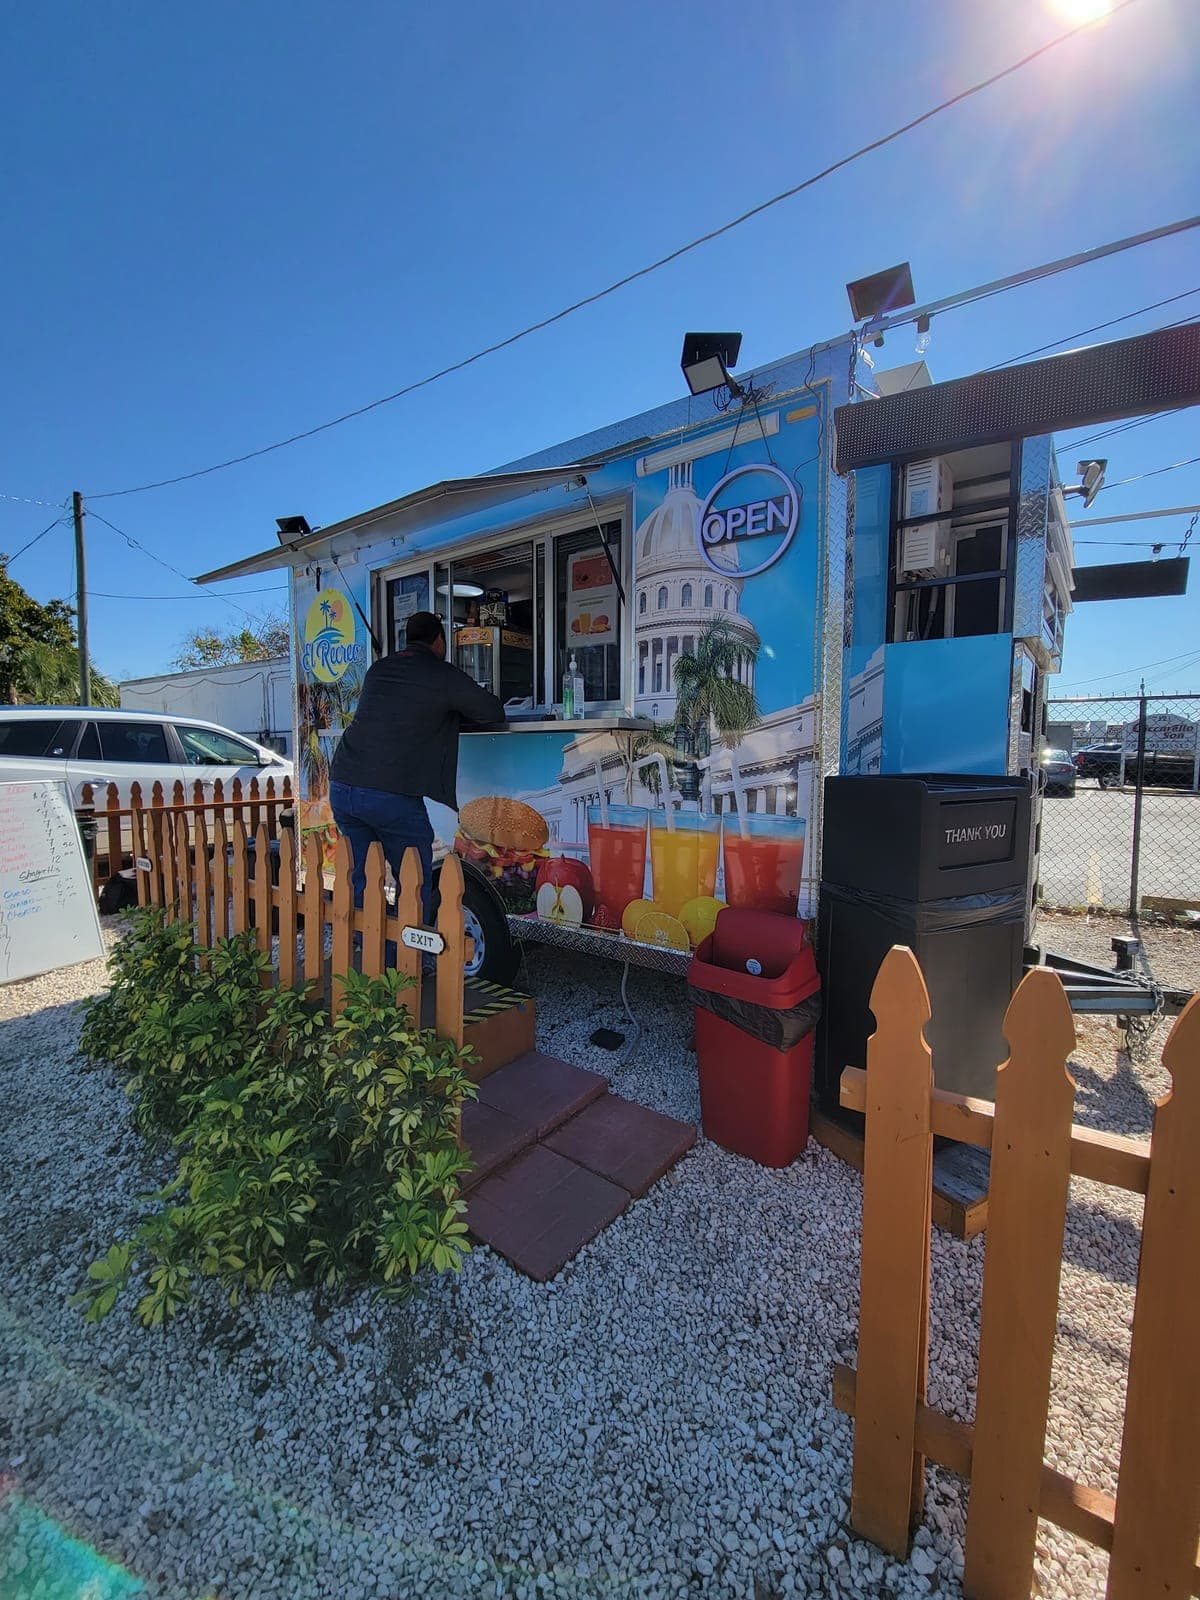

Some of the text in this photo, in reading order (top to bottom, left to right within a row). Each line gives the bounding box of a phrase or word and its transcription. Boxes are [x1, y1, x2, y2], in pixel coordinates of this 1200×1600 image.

[702, 495, 791, 544] OPEN
[302, 638, 361, 677] El Recreo
[945, 824, 1007, 844] THANK YOU
[410, 932, 434, 947] EXIT
